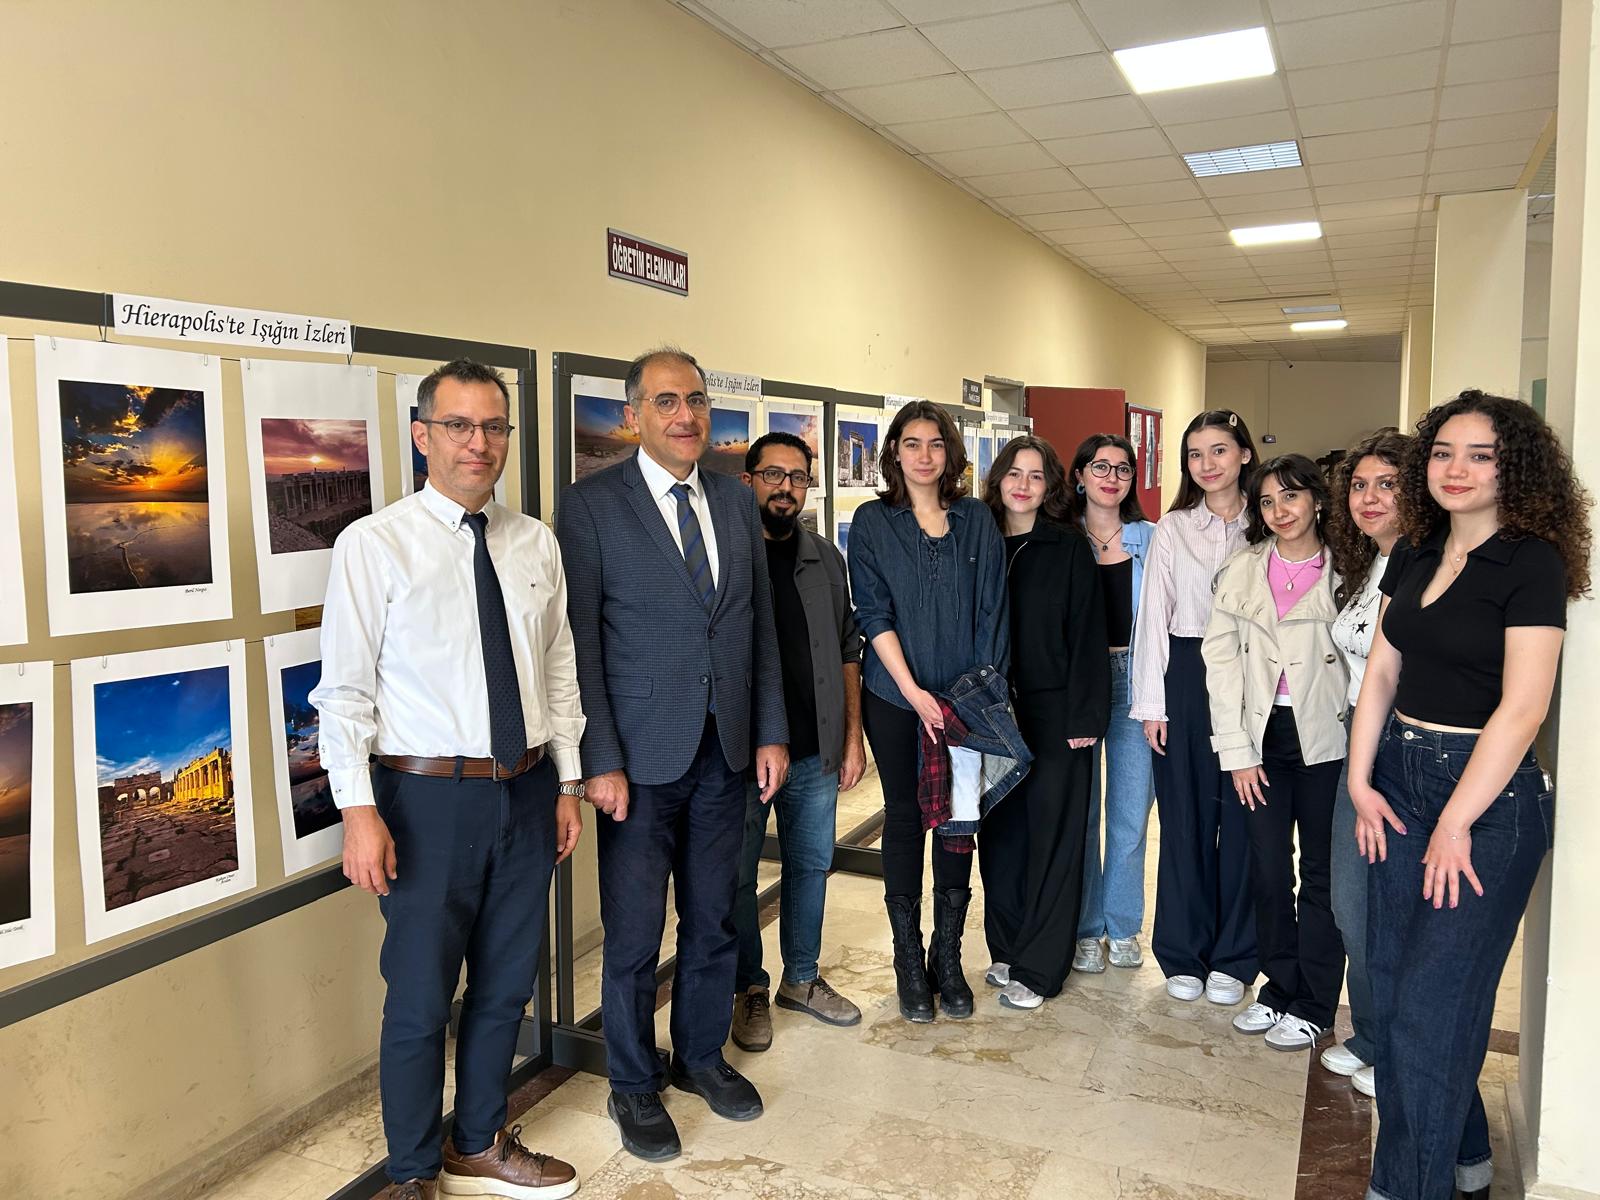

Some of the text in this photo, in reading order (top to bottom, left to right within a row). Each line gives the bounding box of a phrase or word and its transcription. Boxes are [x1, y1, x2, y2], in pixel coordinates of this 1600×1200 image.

[612, 236, 686, 289] ÖĞRETİM ELEMANLARI
[121, 303, 346, 345] Hierapolis'te Işığın İzleri
[705, 373, 724, 388] olis'te
